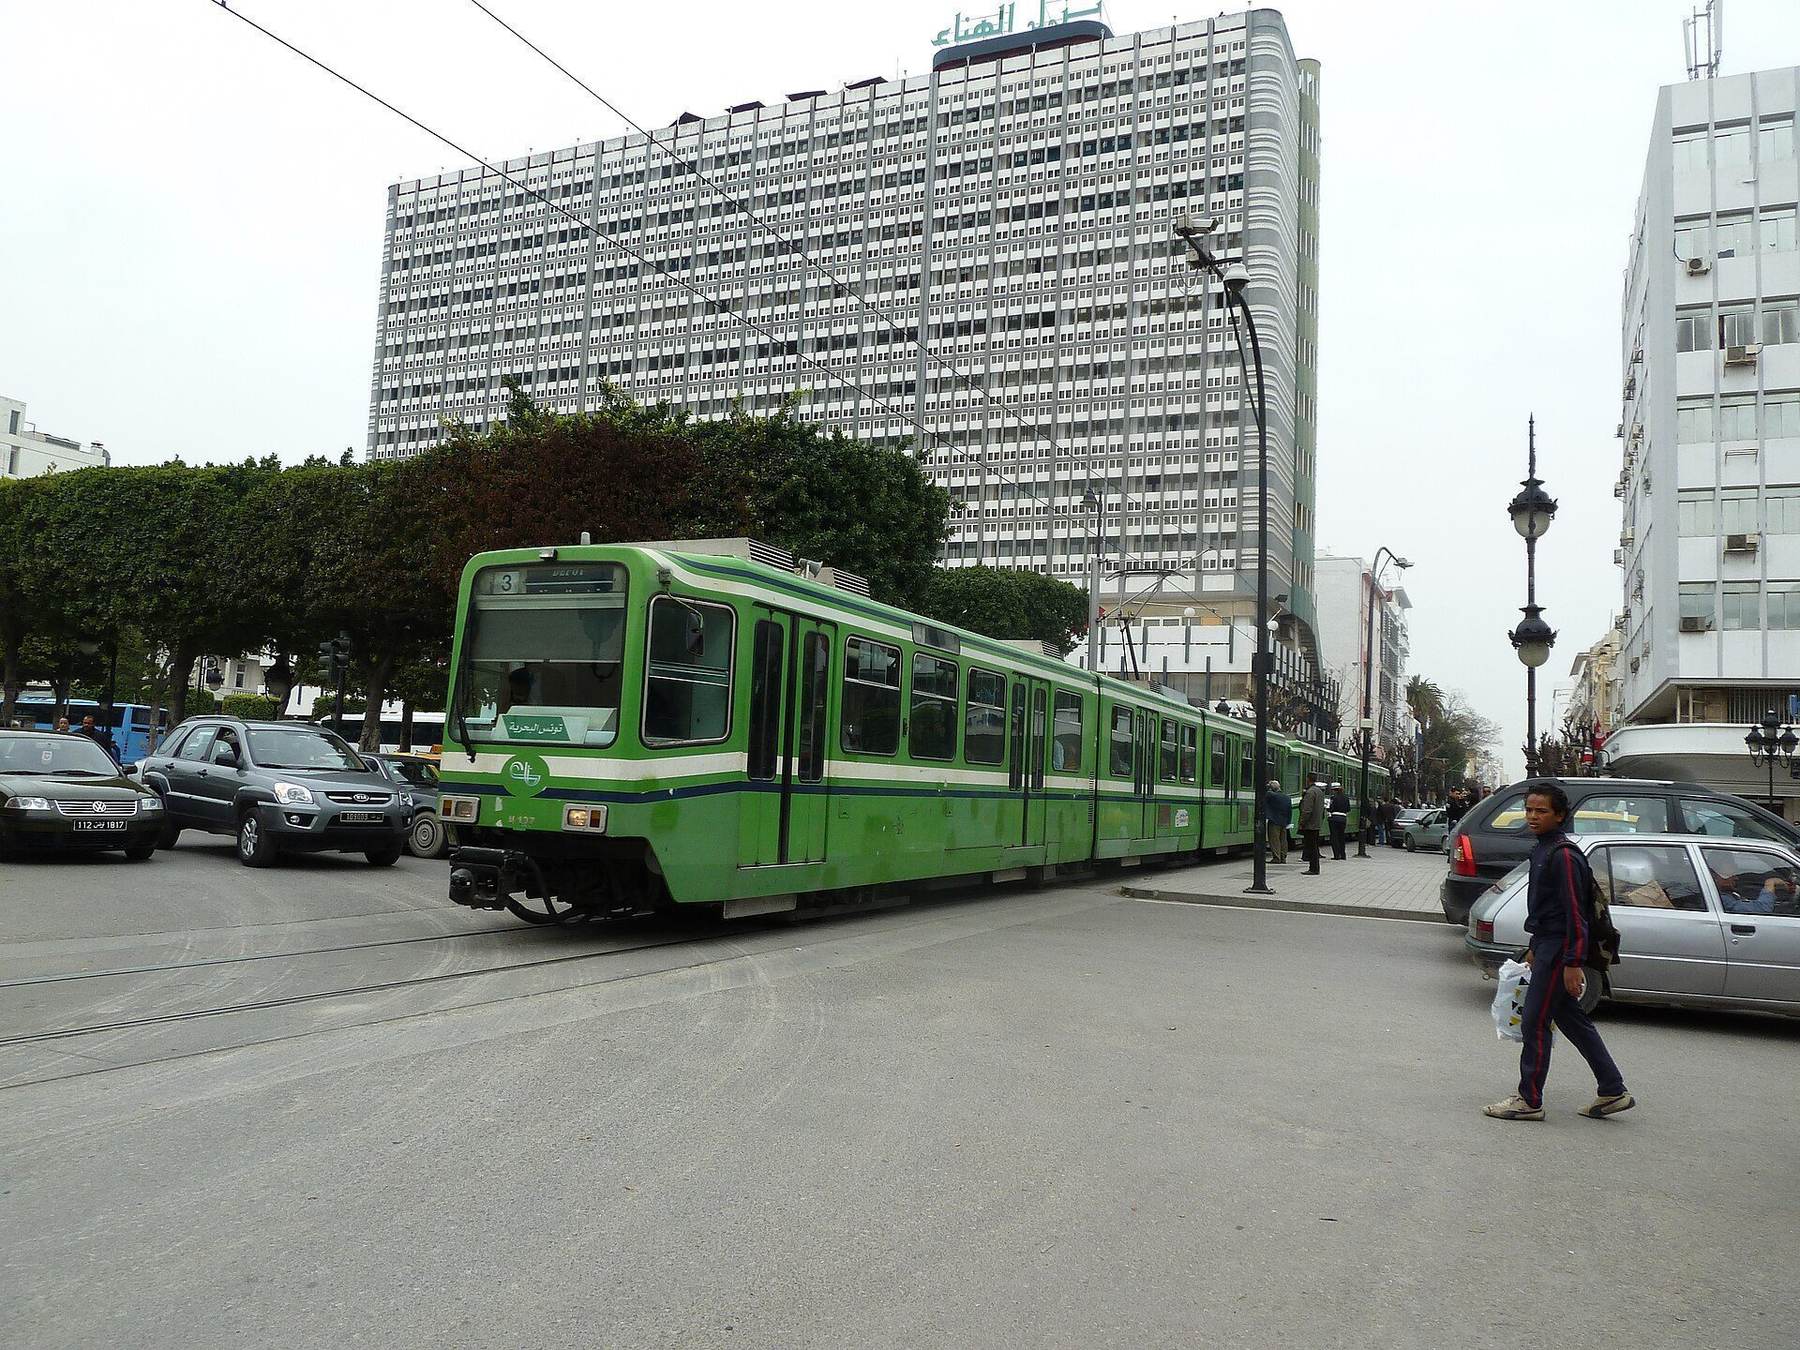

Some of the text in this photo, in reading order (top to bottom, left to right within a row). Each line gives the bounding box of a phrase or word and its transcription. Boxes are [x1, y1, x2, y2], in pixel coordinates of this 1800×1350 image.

[501, 574, 512, 592] 3
[509, 721, 563, 735] تونس البحرية
[78, 821, 92, 829] 112
[107, 821, 125, 829] 1817
